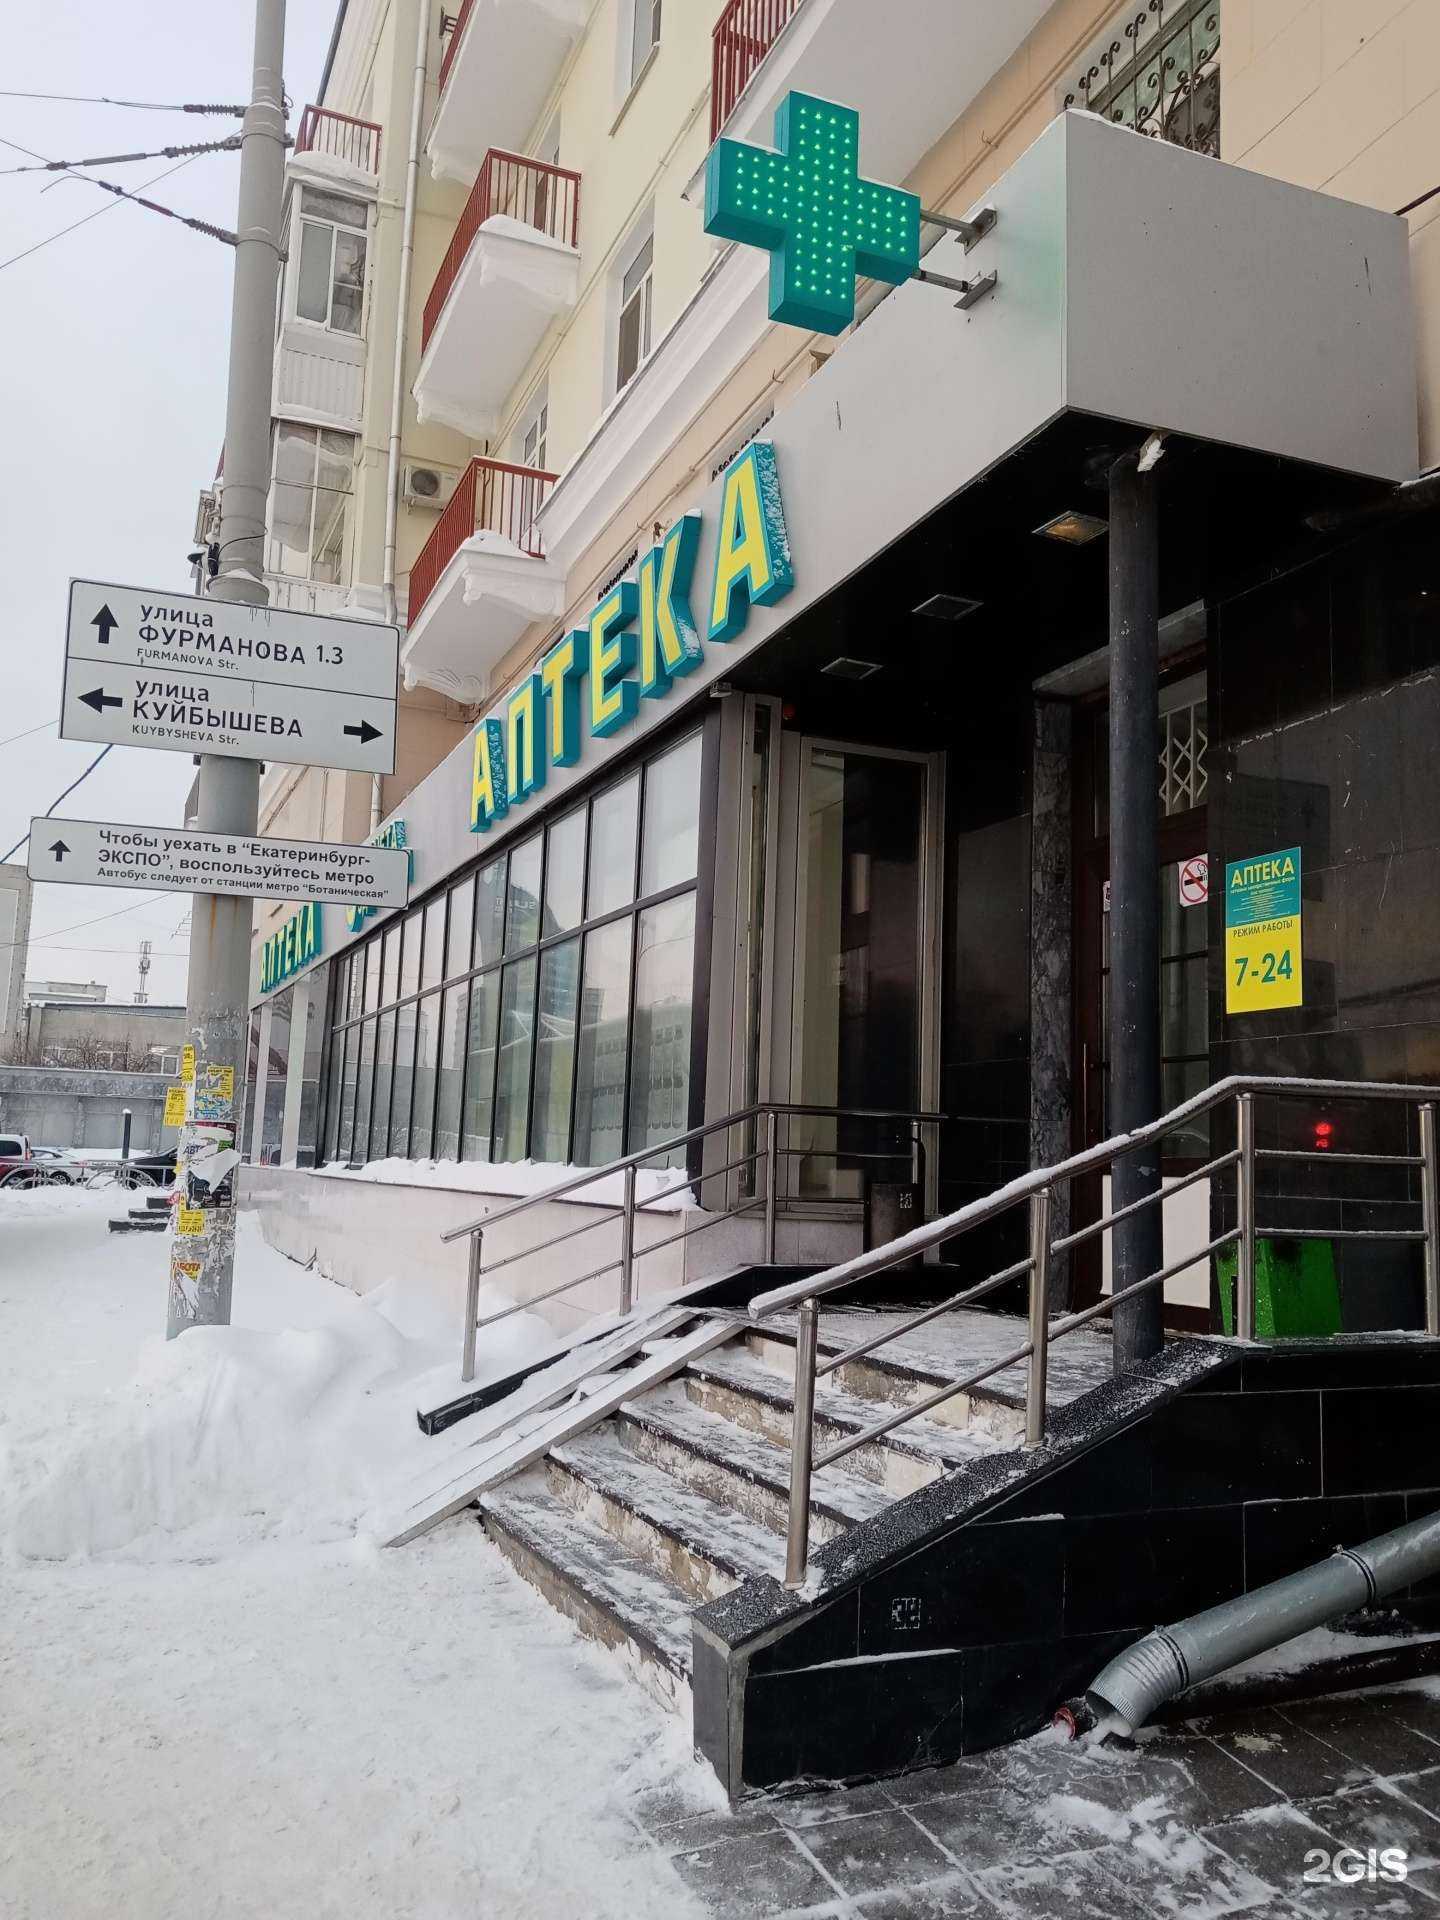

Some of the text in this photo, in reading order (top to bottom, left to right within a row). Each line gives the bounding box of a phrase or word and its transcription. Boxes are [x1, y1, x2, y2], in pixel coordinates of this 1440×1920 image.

[141, 604, 213, 628] улица
[138, 625, 305, 665] ФУРМАНОВА
[470, 438, 794, 832] АПТЕКА
[137, 648, 239, 671] FURMANOVA Str.
[136, 680, 209, 702] улица
[133, 700, 303, 738] КУЙБЫШЕВА
[132, 724, 240, 745] KUYBYSHEVA Str.
[100, 830, 158, 848] Чтобы
[163, 838, 222, 853] уехать
[227, 844, 237, 854] в
[97, 867, 148, 880] Автобус
[150, 872, 198, 884] следует
[200, 876, 214, 885] от
[216, 878, 263, 889] станции
[266, 882, 300, 893] метро
[180, 859, 320, 881] воспользуйтесь
[325, 871, 375, 885] метро
[1231, 856, 1294, 888] АПТЕКА
[1233, 920, 1293, 938] РЕЖИМ РАБОТЫ
[260, 900, 322, 993] АПТЕКА
[1235, 949, 1292, 987] 7-24
